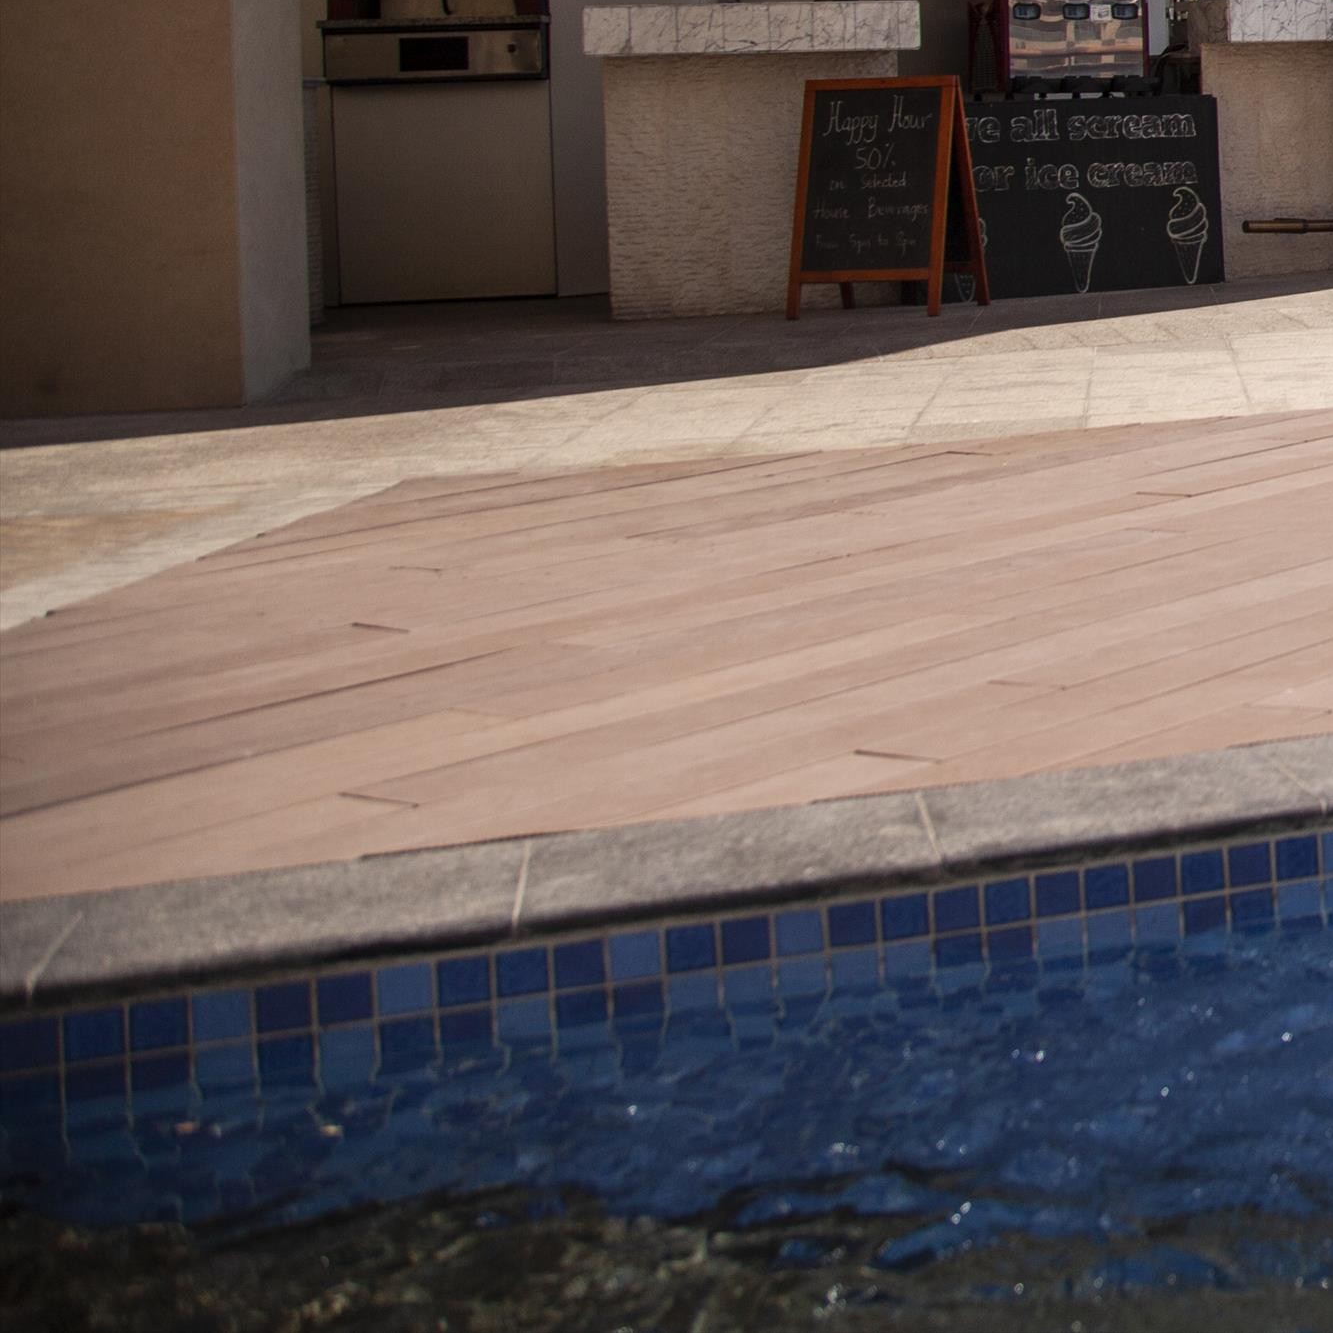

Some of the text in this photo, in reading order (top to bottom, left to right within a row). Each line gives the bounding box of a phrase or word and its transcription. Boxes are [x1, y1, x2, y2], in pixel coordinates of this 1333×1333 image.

[822, 94, 933, 146] Happy Hour
[1010, 108, 1060, 142] all
[1067, 113, 1197, 141] scream
[853, 142, 897, 171] 50%
[829, 179, 846, 192] on
[1024, 157, 1080, 191] ice
[1087, 161, 1199, 187] cream
